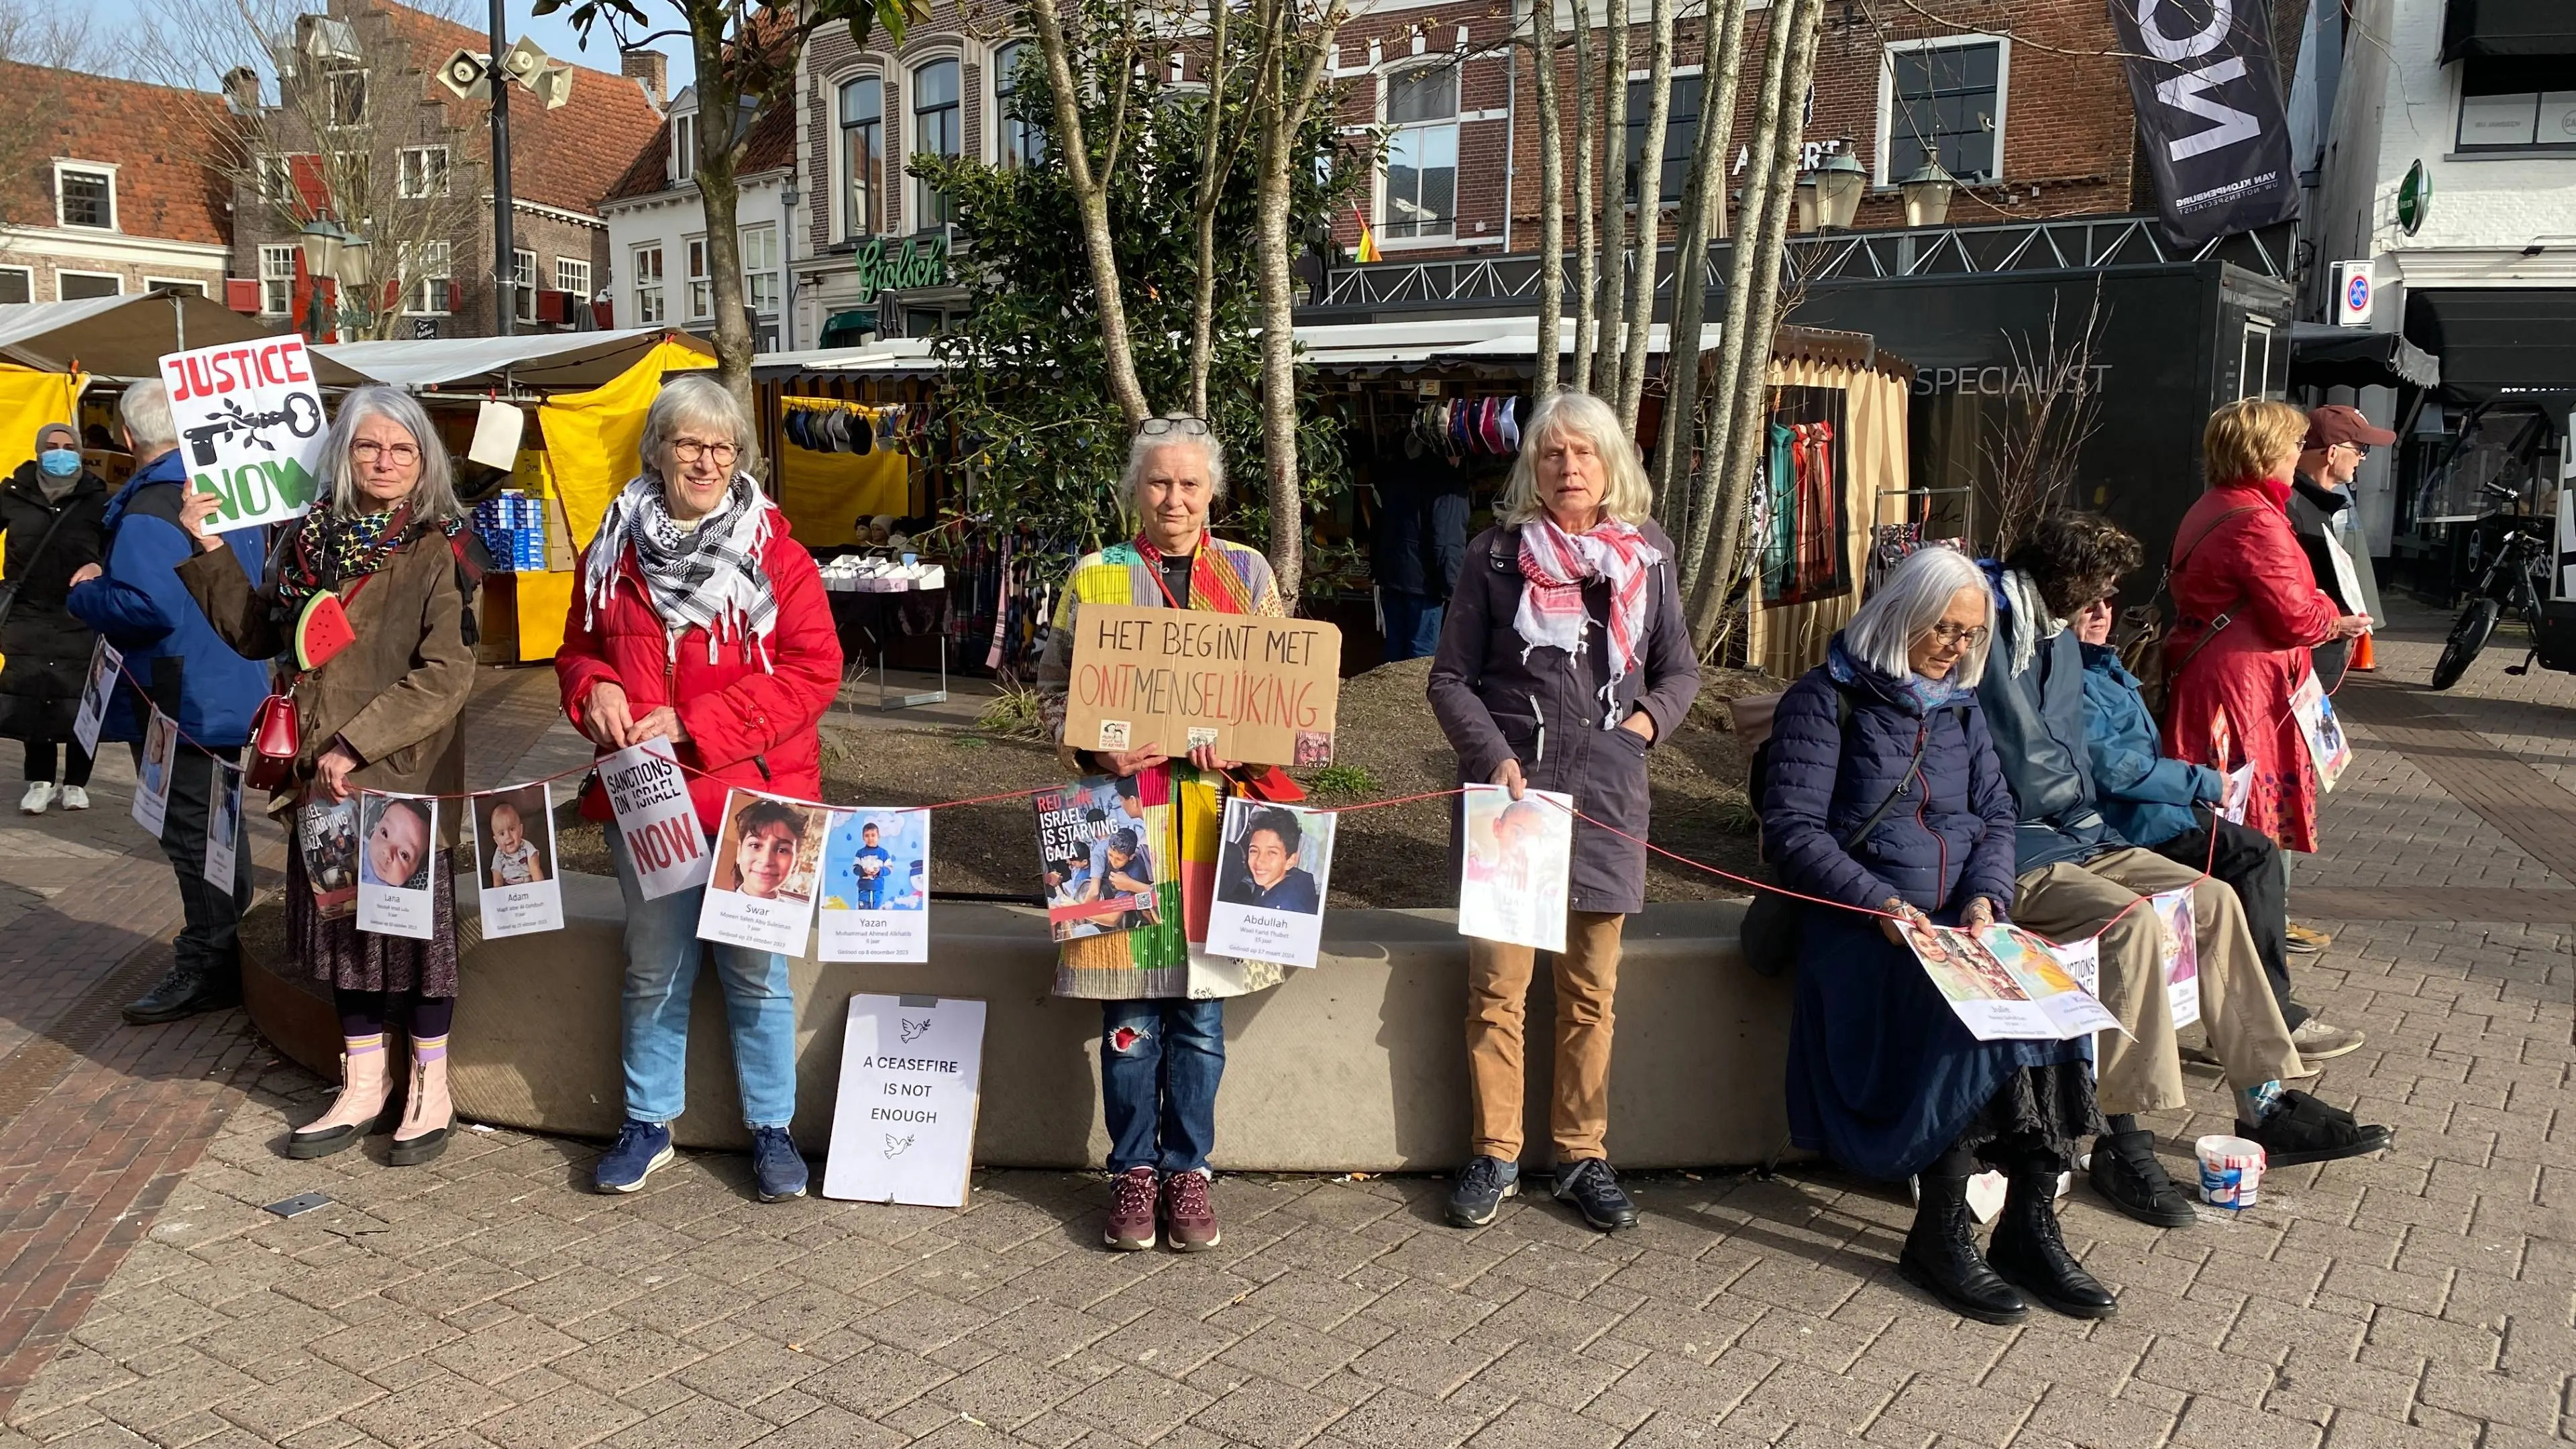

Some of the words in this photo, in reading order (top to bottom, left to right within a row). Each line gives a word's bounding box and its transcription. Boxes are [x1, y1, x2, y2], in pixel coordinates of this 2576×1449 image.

[855, 235, 945, 303] Grolsch
[168, 342, 309, 401] JUSTICE
[194, 457, 321, 525] NOW
[1099, 620, 1152, 651] HET
[1265, 629, 1318, 666] MET
[607, 757, 672, 794] SANCTIONS
[614, 793, 631, 815] ON
[631, 777, 681, 810] ISRAEL
[1037, 794, 1061, 812] RED
[306, 811, 348, 835] STARVING
[1040, 808, 1084, 829] ISRAEL
[1042, 829, 1055, 846] IS
[1058, 818, 1119, 843] STARVING
[303, 835, 323, 852] GAZA
[627, 812, 704, 875] NOW.
[1044, 843, 1078, 862] GAZA
[384, 894, 400, 903] Lana
[508, 893, 529, 902] Adam
[746, 904, 769, 916] Swar
[859, 918, 887, 927] Yazan
[1244, 914, 1288, 928] Abdullah
[863, 1056, 873, 1068] A
[877, 1057, 958, 1073] CEASEFIRE
[883, 1082, 897, 1095] IS
[901, 1084, 932, 1097] NOT
[871, 1108, 937, 1124] ENOUGH
